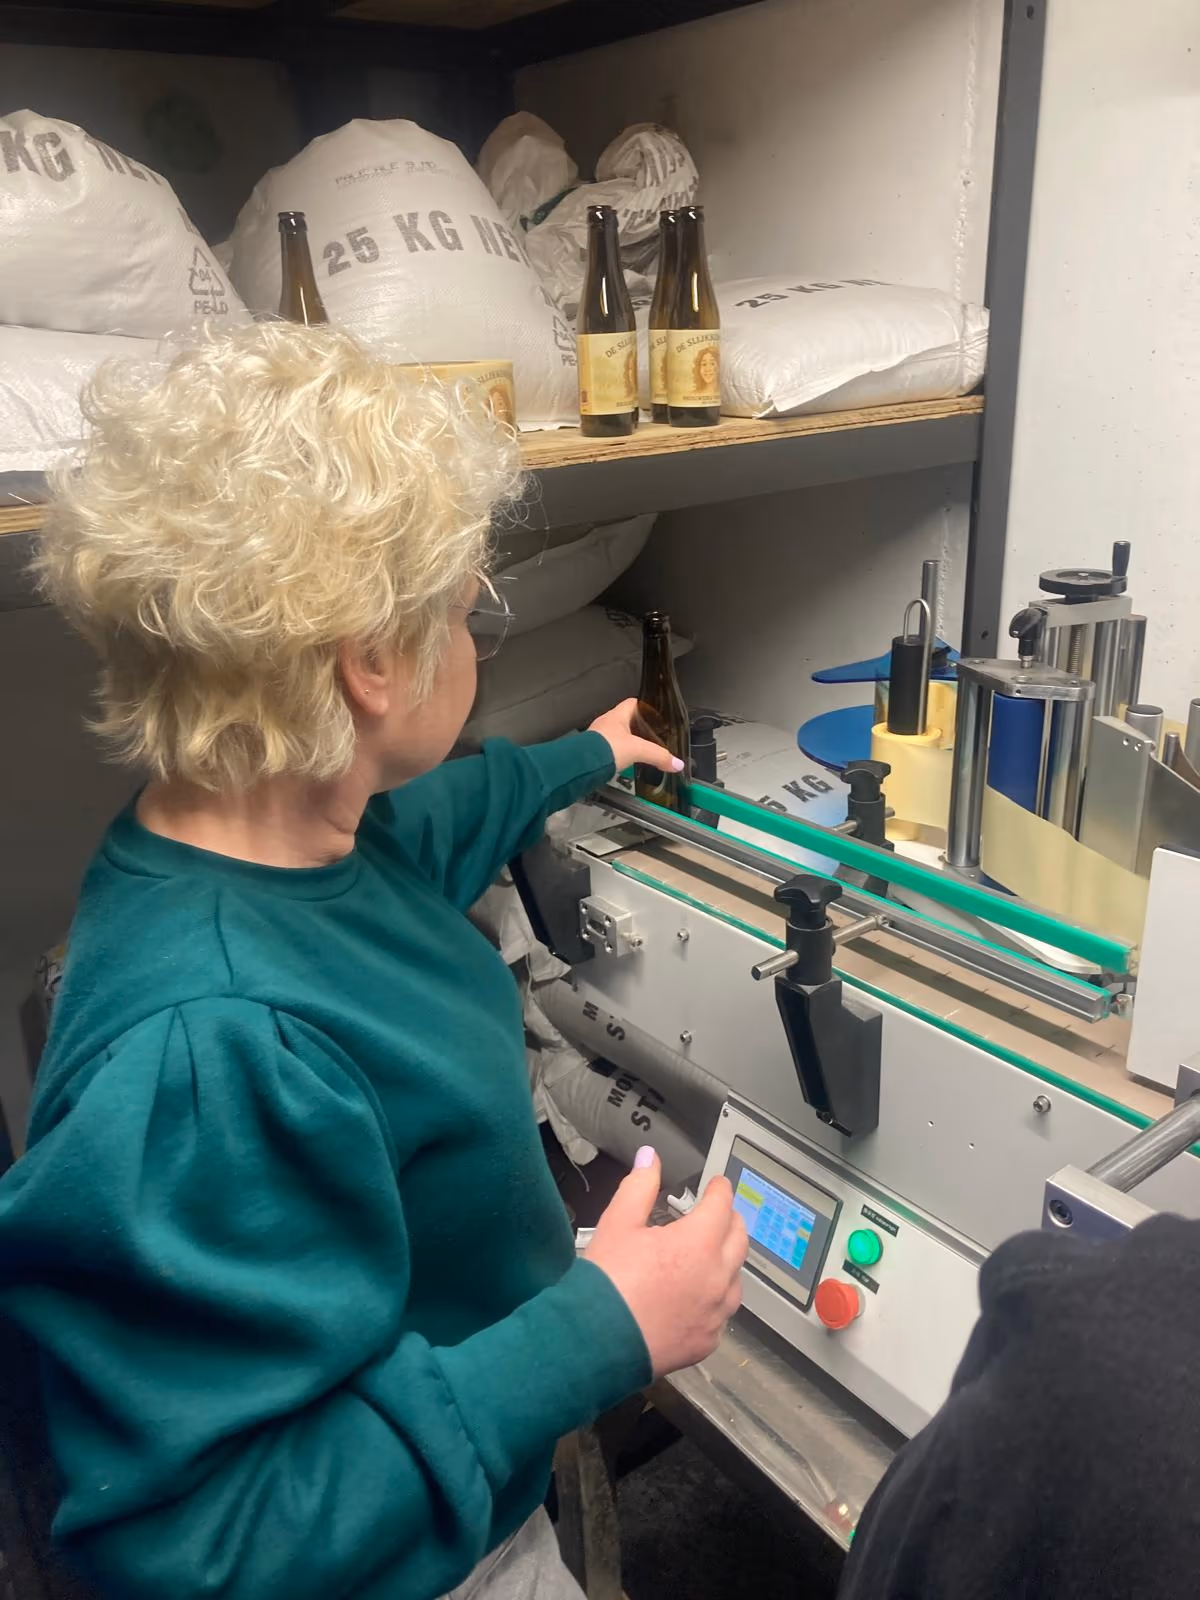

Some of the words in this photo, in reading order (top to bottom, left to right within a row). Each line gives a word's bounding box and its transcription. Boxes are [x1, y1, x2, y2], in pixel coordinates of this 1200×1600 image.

[0, 130, 76, 182] KG
[322, 226, 380, 277] 25
[392, 210, 464, 253] KG
[735, 292, 789, 309] 25
[787, 281, 843, 294] KG
[782, 774, 834, 804] KG
